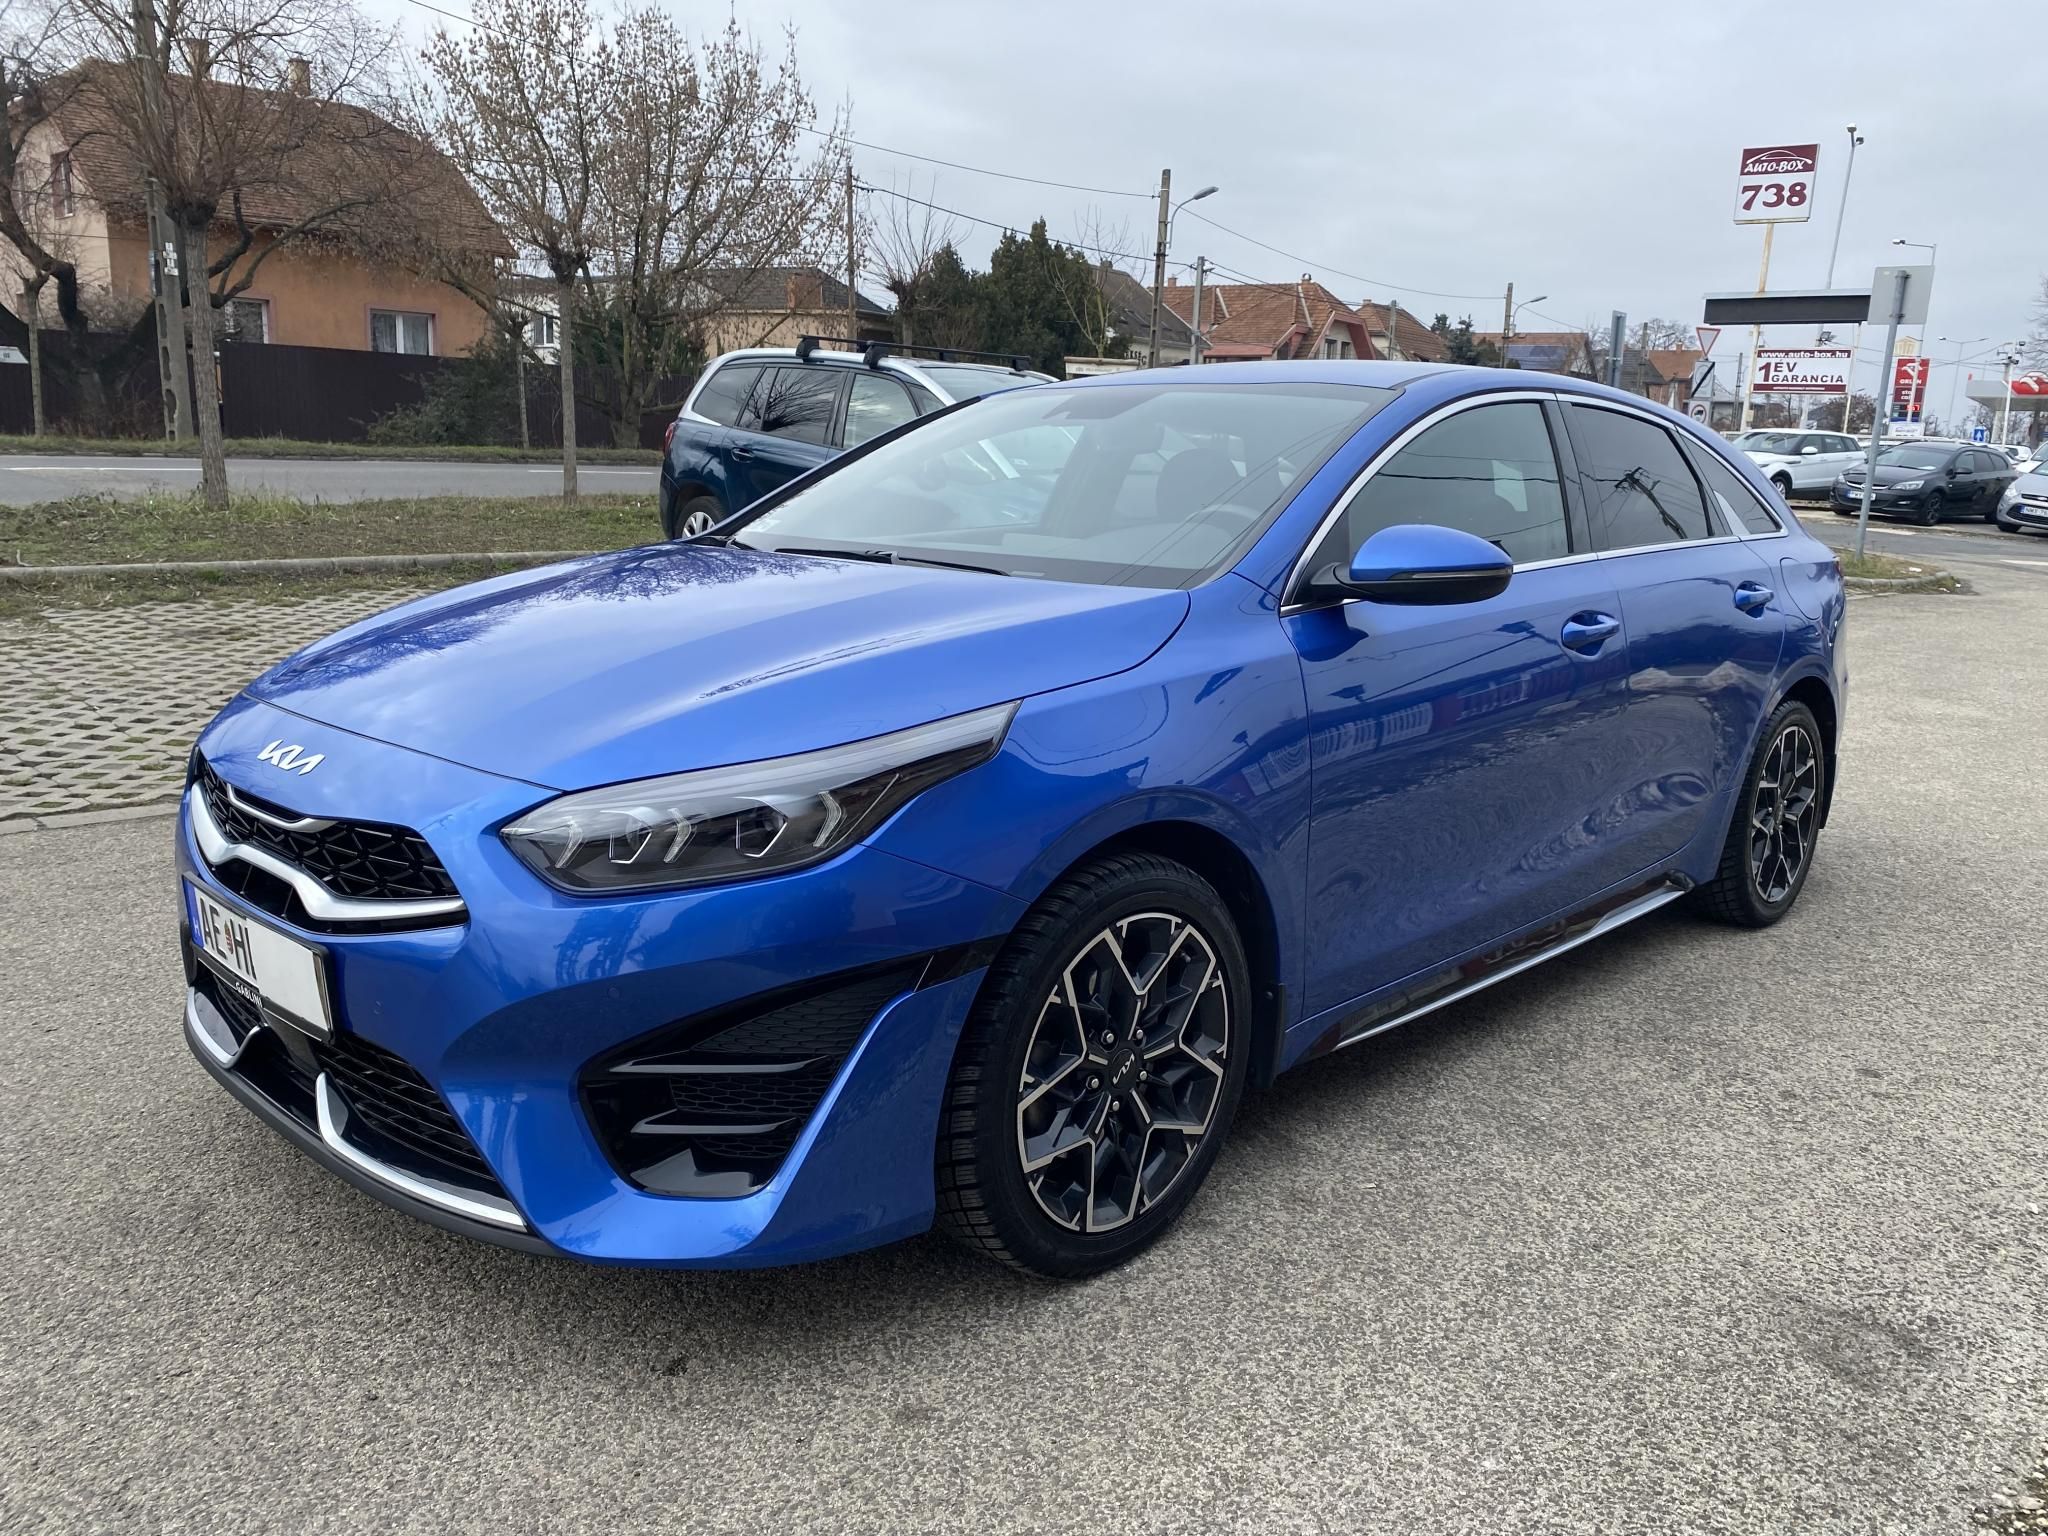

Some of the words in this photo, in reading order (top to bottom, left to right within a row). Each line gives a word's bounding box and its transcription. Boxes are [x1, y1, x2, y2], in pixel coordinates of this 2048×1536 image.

[1744, 160, 1805, 173] AUTO-BOX
[1741, 182, 1807, 211] 738
[1761, 350, 1848, 359] www.auto-box.hu
[1758, 362, 1771, 382] 1
[1773, 359, 1797, 372] ÉV
[1771, 375, 1844, 383] GARANCIA
[257, 739, 326, 776] KIA
[200, 897, 228, 960] AE
